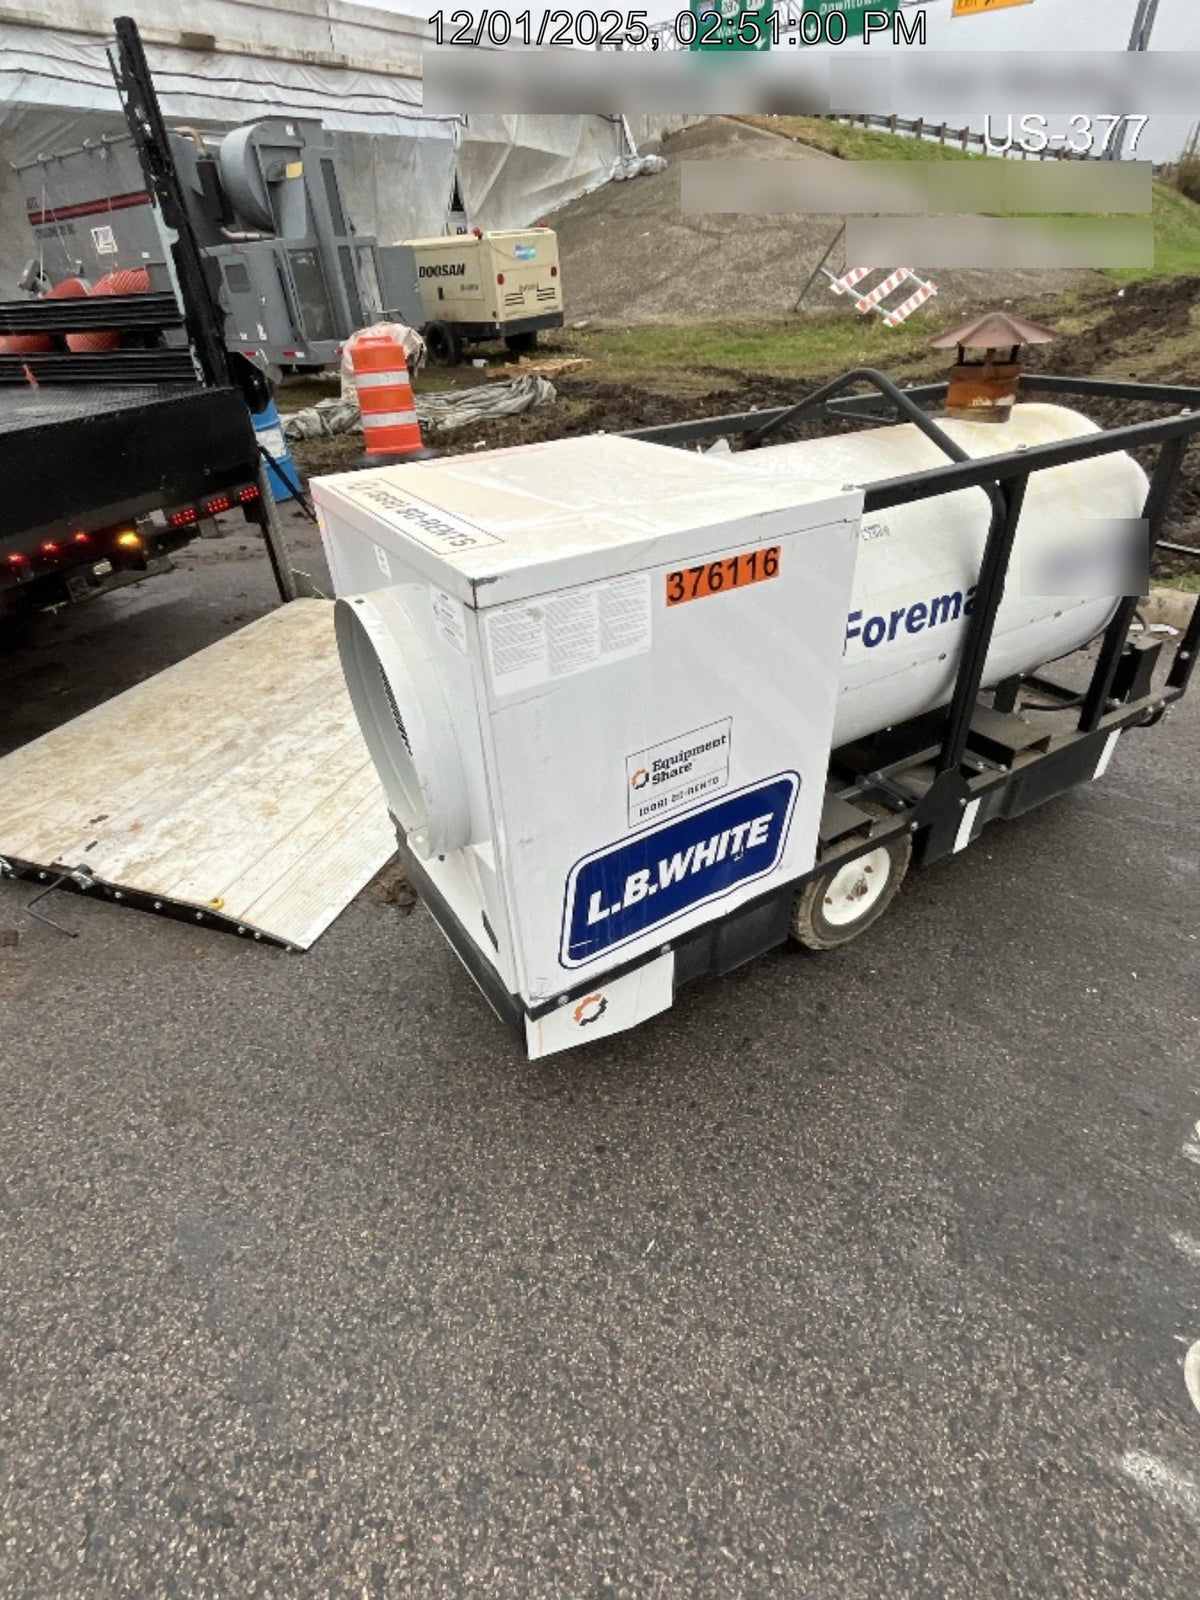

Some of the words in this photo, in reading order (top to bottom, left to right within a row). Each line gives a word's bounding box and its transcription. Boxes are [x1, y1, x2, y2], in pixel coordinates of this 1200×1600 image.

[419, 263, 466, 278] DOOSAN
[668, 546, 779, 602] 376116
[651, 734, 727, 773] Equipment
[651, 761, 693, 785] Share
[586, 812, 775, 926] L.B.WHITE
